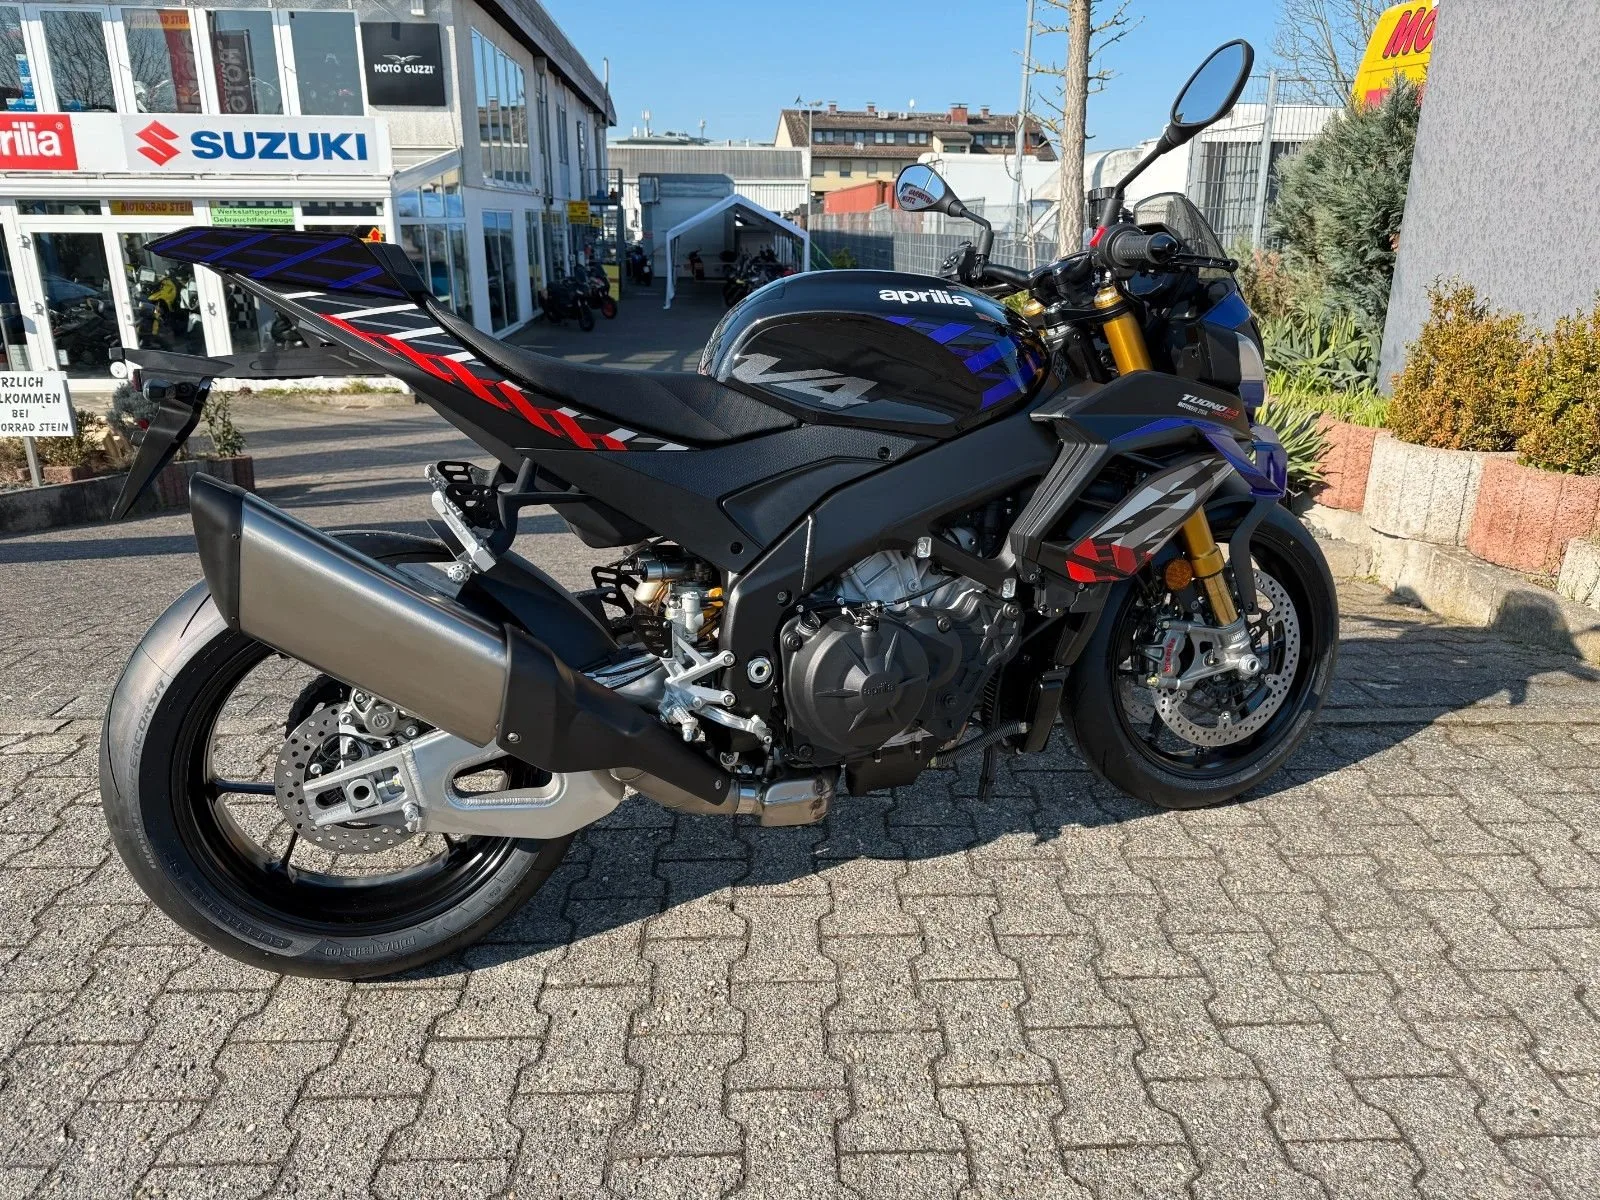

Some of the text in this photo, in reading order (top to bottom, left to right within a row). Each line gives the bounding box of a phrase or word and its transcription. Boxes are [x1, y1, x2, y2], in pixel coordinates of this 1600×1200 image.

[374, 64, 434, 74] MOTO GUZZI
[190, 131, 368, 161] SUZUKI
[120, 201, 168, 212] MOTORRAD
[879, 289, 973, 307] aprilia
[1, 377, 43, 388] RZLICH
[732, 353, 878, 407] V4
[1182, 393, 1228, 412] TUONO
[12, 409, 29, 418] BEI
[1, 423, 69, 433] ORRAD STEIN
